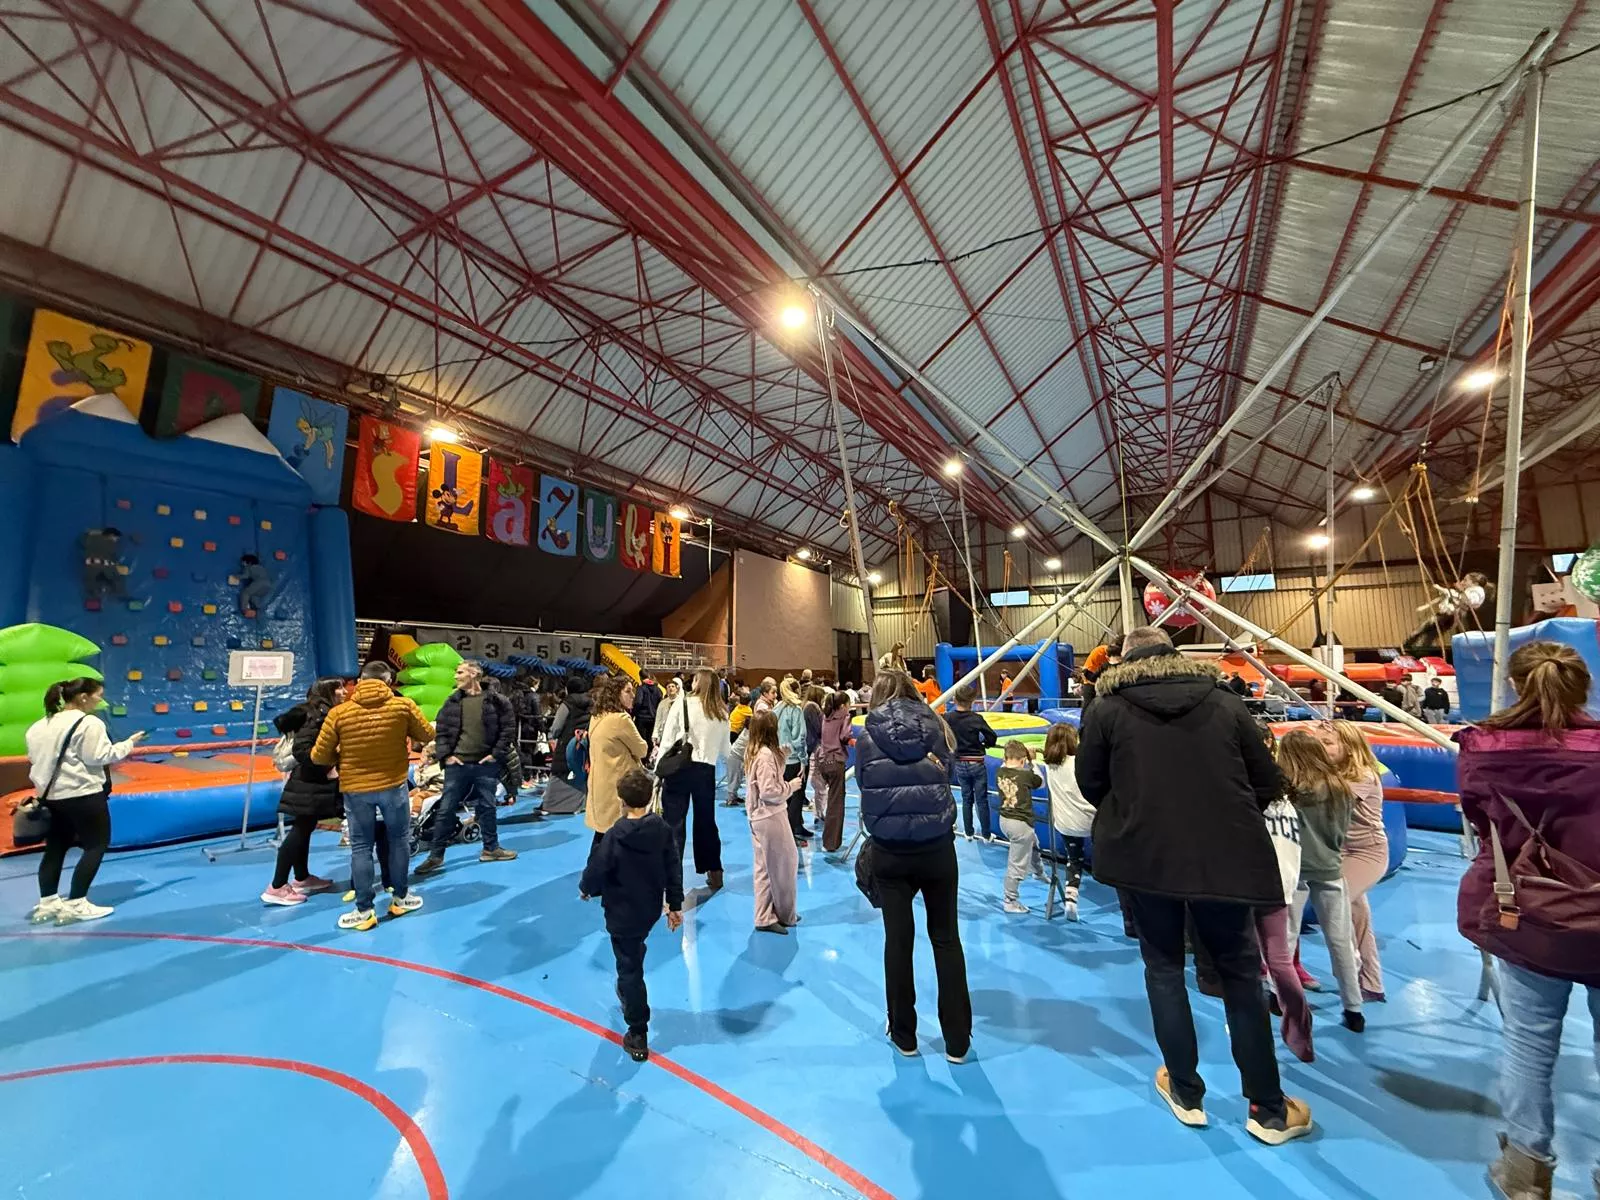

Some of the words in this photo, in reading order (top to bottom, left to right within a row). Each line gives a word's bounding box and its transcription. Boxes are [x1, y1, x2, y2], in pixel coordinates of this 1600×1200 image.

[456, 635, 472, 651] 2
[485, 643, 500, 658] 3
[512, 635, 525, 650] 4
[536, 645, 549, 659] 5
[559, 640, 572, 654] 6
[582, 648, 592, 660] 7
